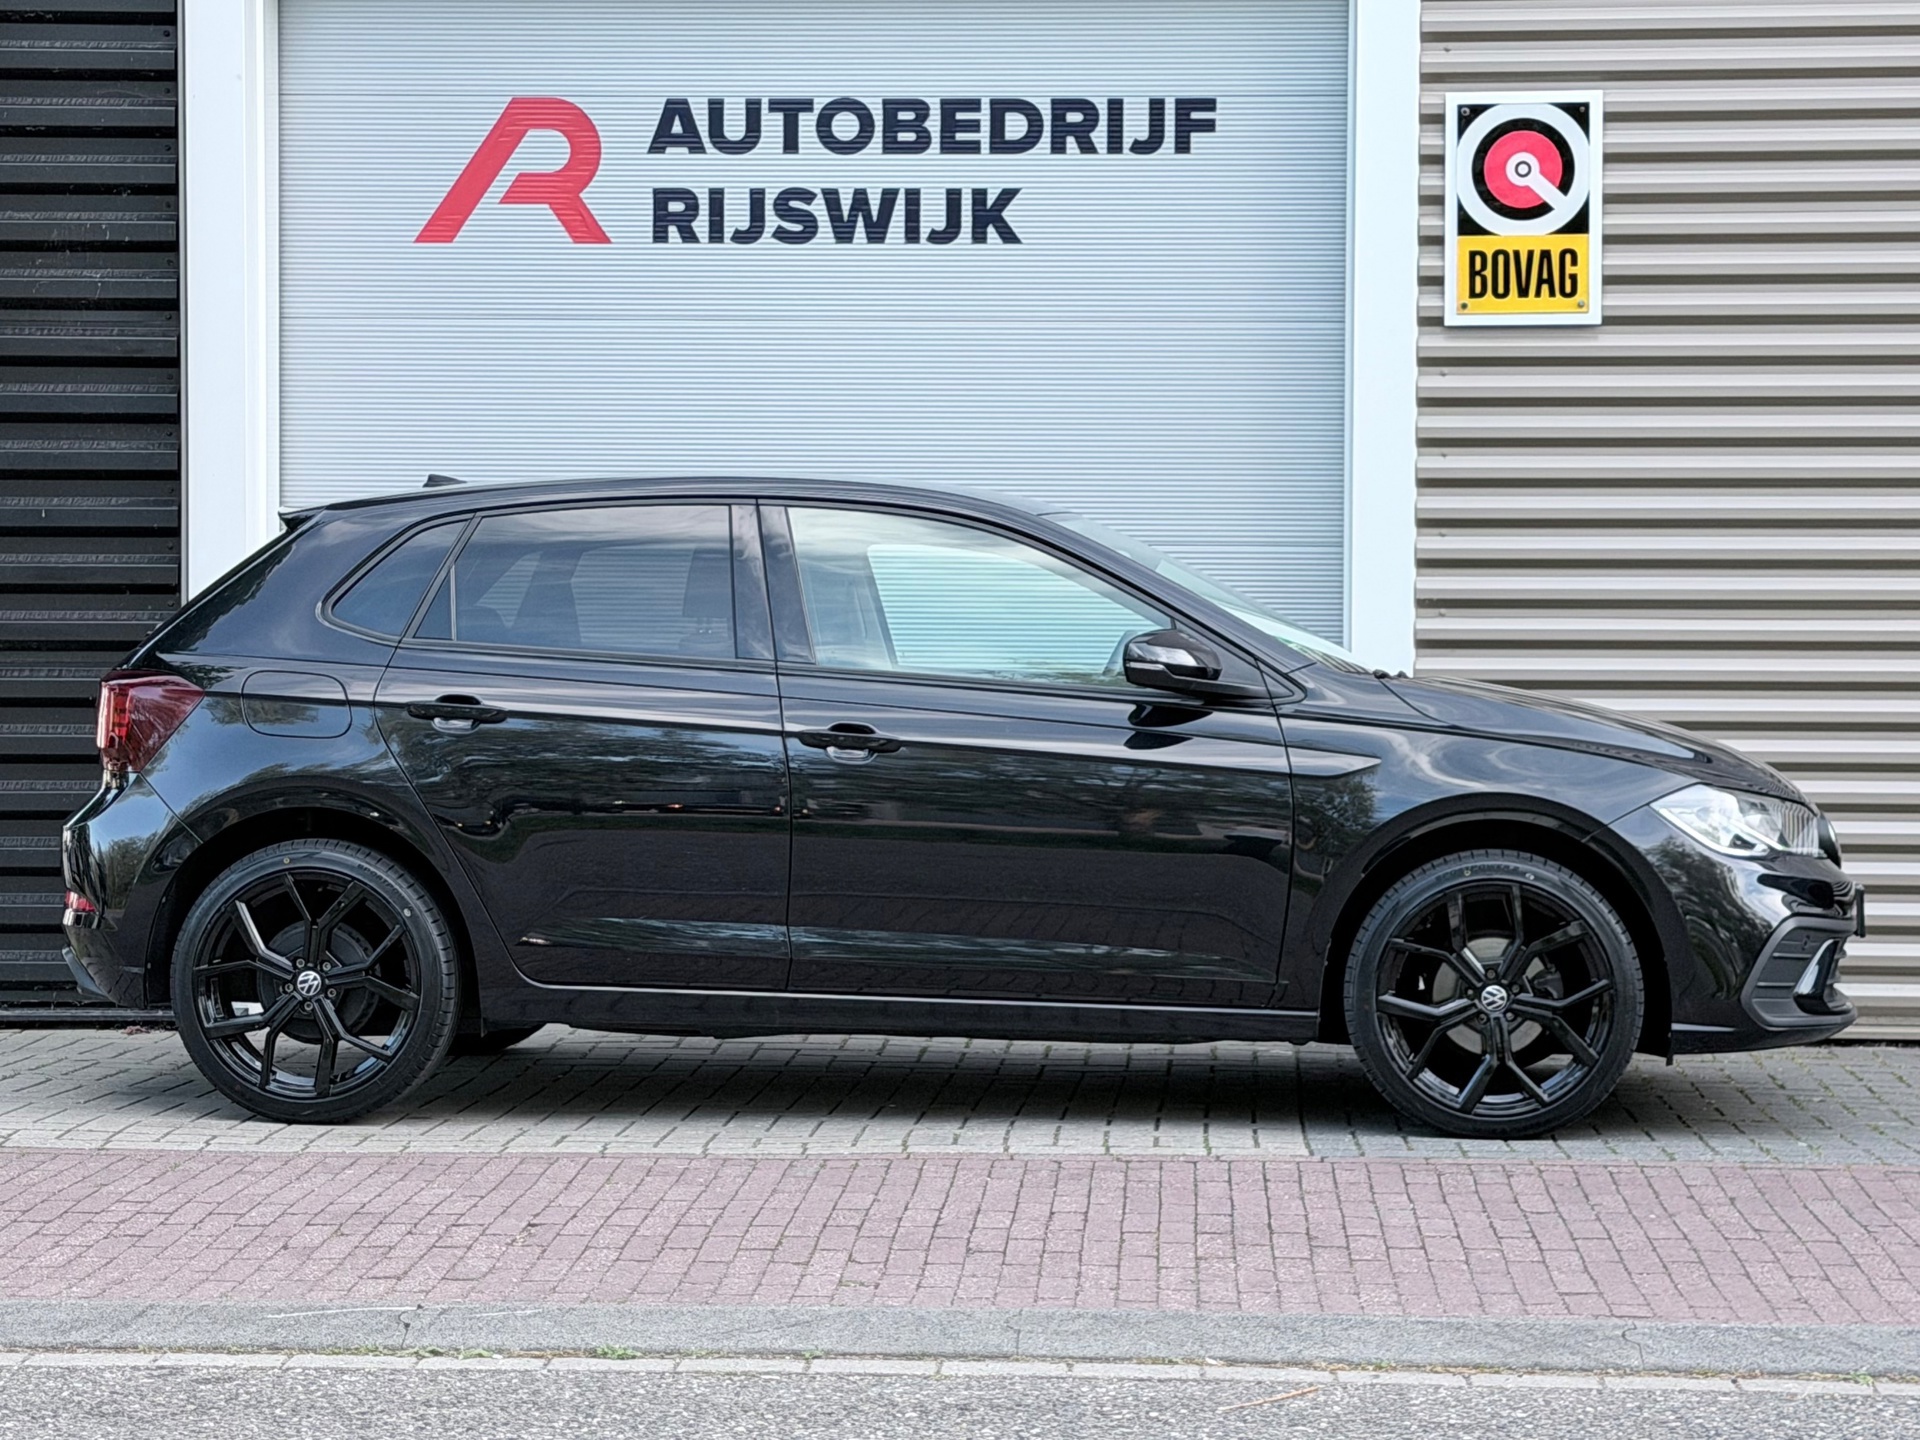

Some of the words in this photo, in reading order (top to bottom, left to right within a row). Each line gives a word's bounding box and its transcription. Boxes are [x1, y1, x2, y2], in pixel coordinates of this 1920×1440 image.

[647, 98, 1217, 155] AUTOBEDRIJF
[652, 188, 1021, 245] RIJSWIJK
[1468, 248, 1579, 300] BOVAG
